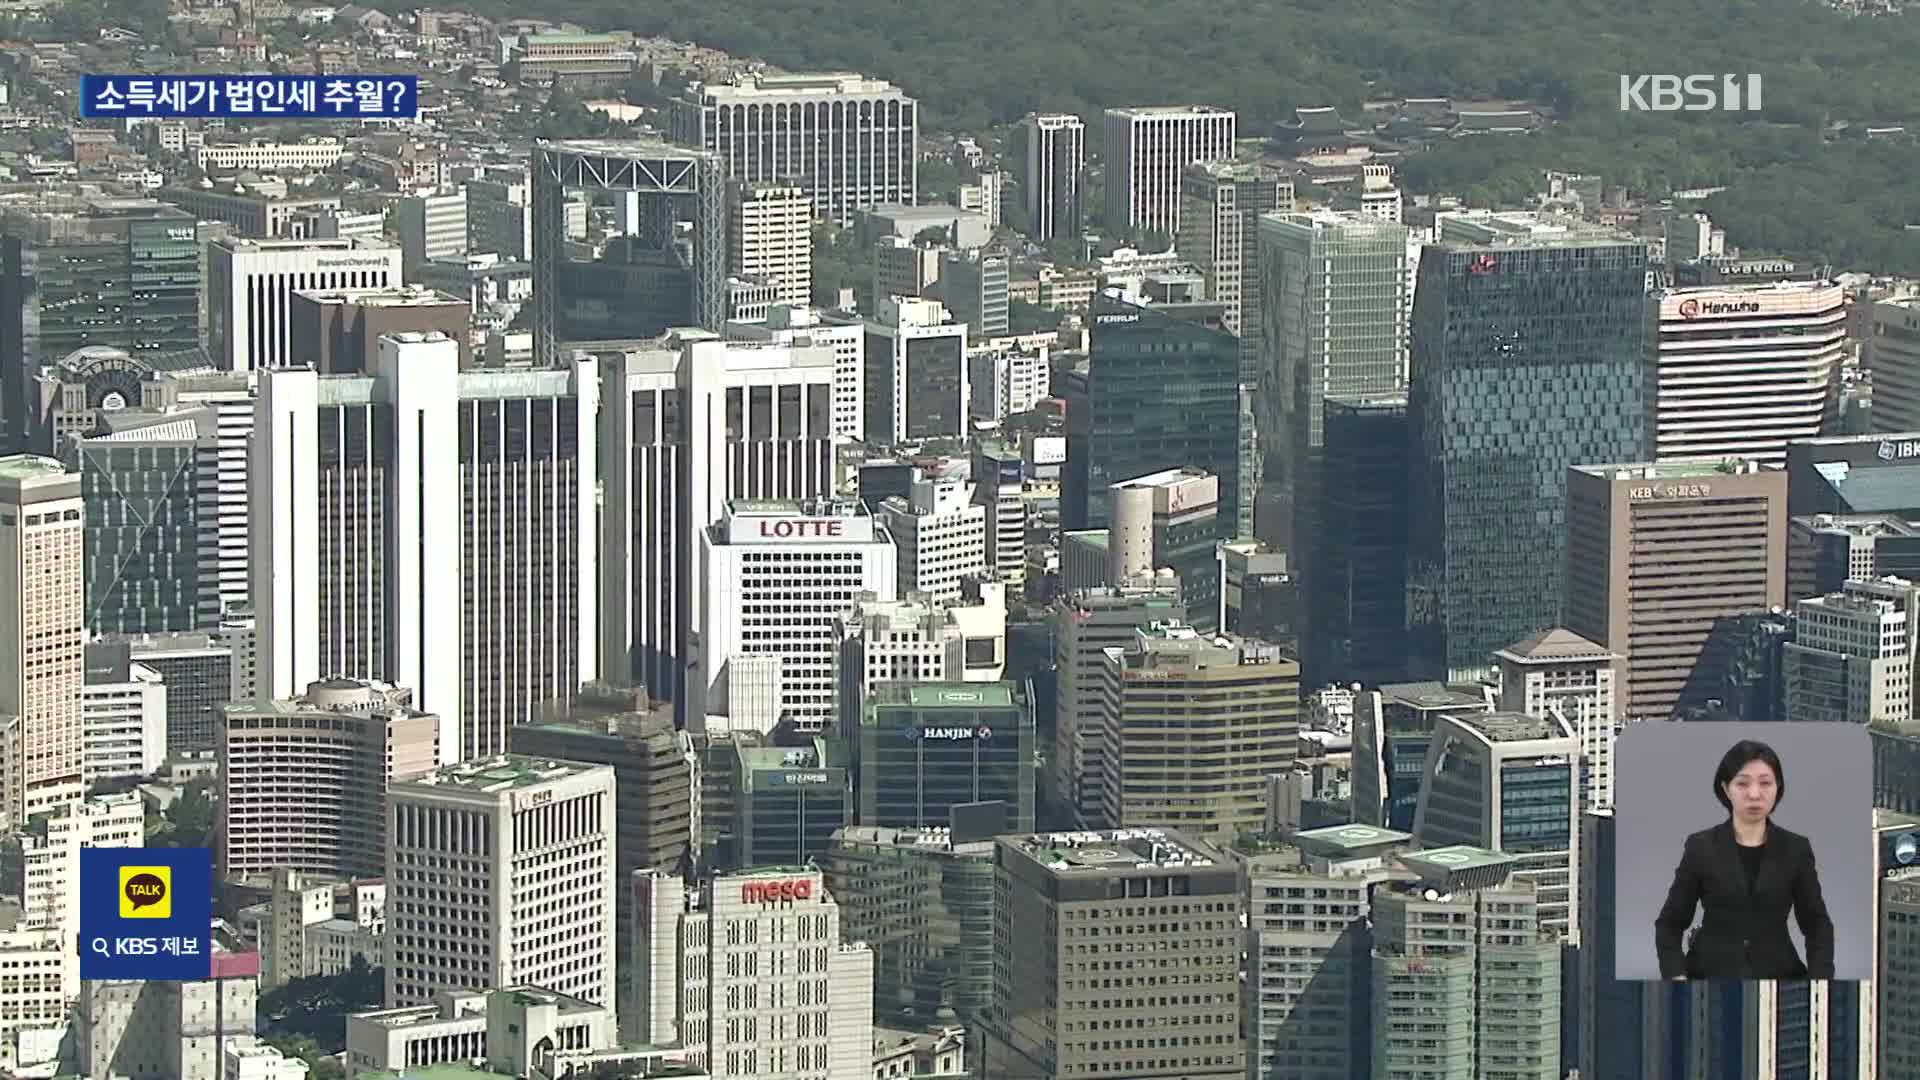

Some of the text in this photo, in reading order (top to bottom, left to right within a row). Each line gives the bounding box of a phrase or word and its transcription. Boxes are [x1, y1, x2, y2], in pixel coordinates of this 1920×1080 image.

[1702, 301, 1760, 314] Hanwha
[1097, 315, 1139, 323] FERRUM
[1629, 487, 1653, 499] KEB
[760, 521, 842, 538] LOTTE
[924, 727, 973, 740] HANJIN
[742, 880, 811, 904] mesa
